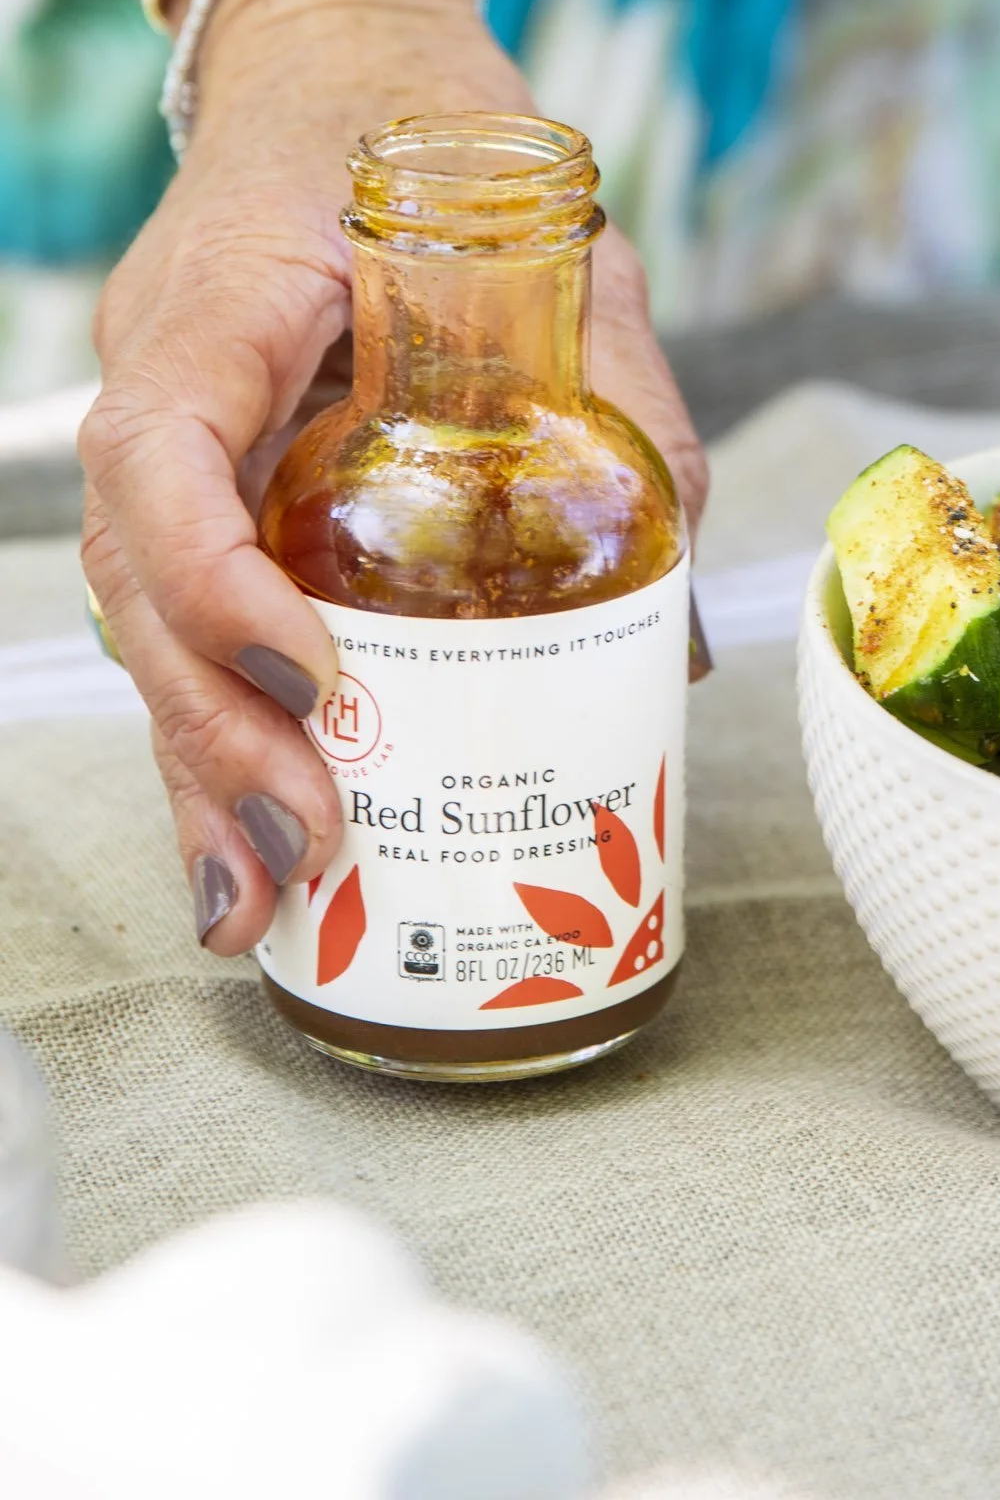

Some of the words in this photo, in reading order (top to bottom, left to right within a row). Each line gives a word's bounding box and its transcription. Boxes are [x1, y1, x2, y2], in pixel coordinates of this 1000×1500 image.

[330, 634, 418, 660] IGHTENS
[430, 643, 560, 662] EVERYTHING
[569, 637, 587, 653] IT
[594, 611, 661, 644] TOUCHES
[324, 762, 369, 778] OUSE
[373, 743, 394, 768] LAB
[442, 769, 556, 789] ORGANIC
[350, 790, 425, 833] Red
[441, 782, 636, 835] Sunflower
[379, 845, 430, 862] REAL
[441, 850, 500, 863] FOOD
[514, 830, 612, 860] DRESSING
[456, 926, 493, 936] MADE
[499, 923, 533, 935] WITH
[456, 940, 518, 952] ORGANIC
[524, 938, 541, 948] CA
[546, 930, 581, 944] EVOO
[405, 951, 439, 963] CCOF
[456, 960, 487, 982] 8FL
[572, 944, 596, 969] ML
